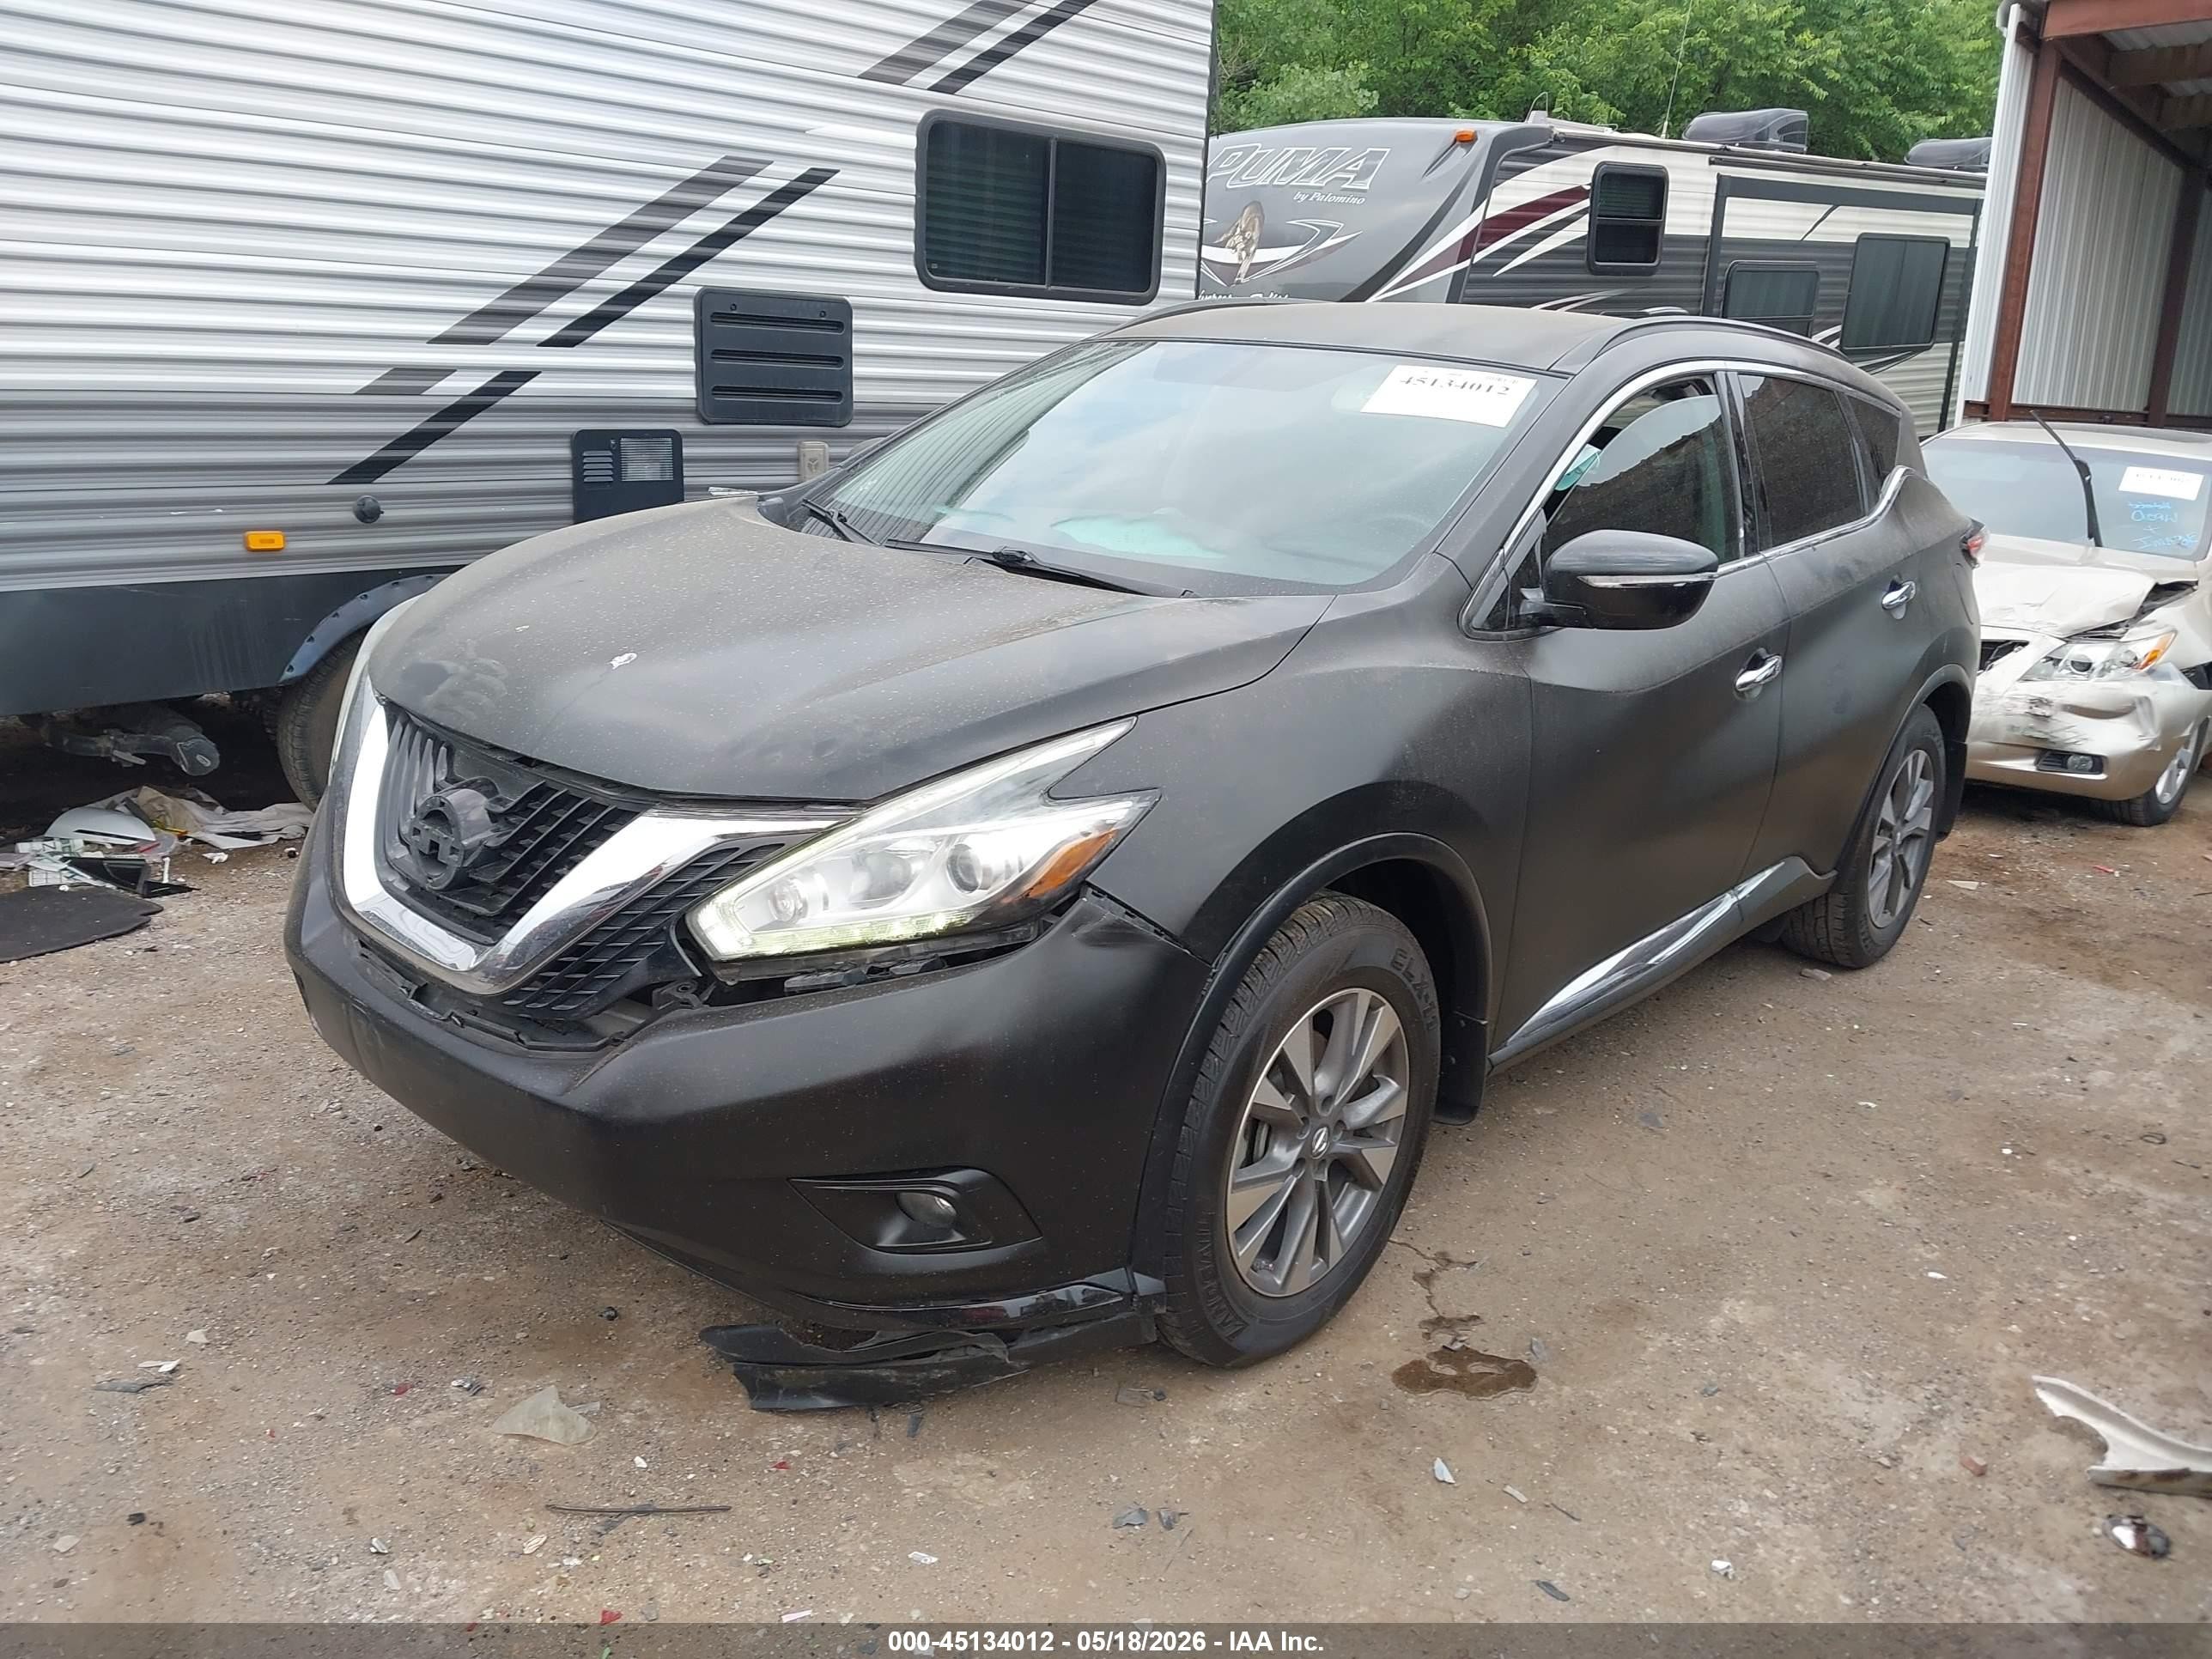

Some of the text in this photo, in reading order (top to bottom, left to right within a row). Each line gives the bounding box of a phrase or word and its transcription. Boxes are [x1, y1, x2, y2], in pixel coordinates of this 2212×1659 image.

[1206, 143, 1390, 190] PUMA
[1293, 191, 1366, 205] by Palomino
